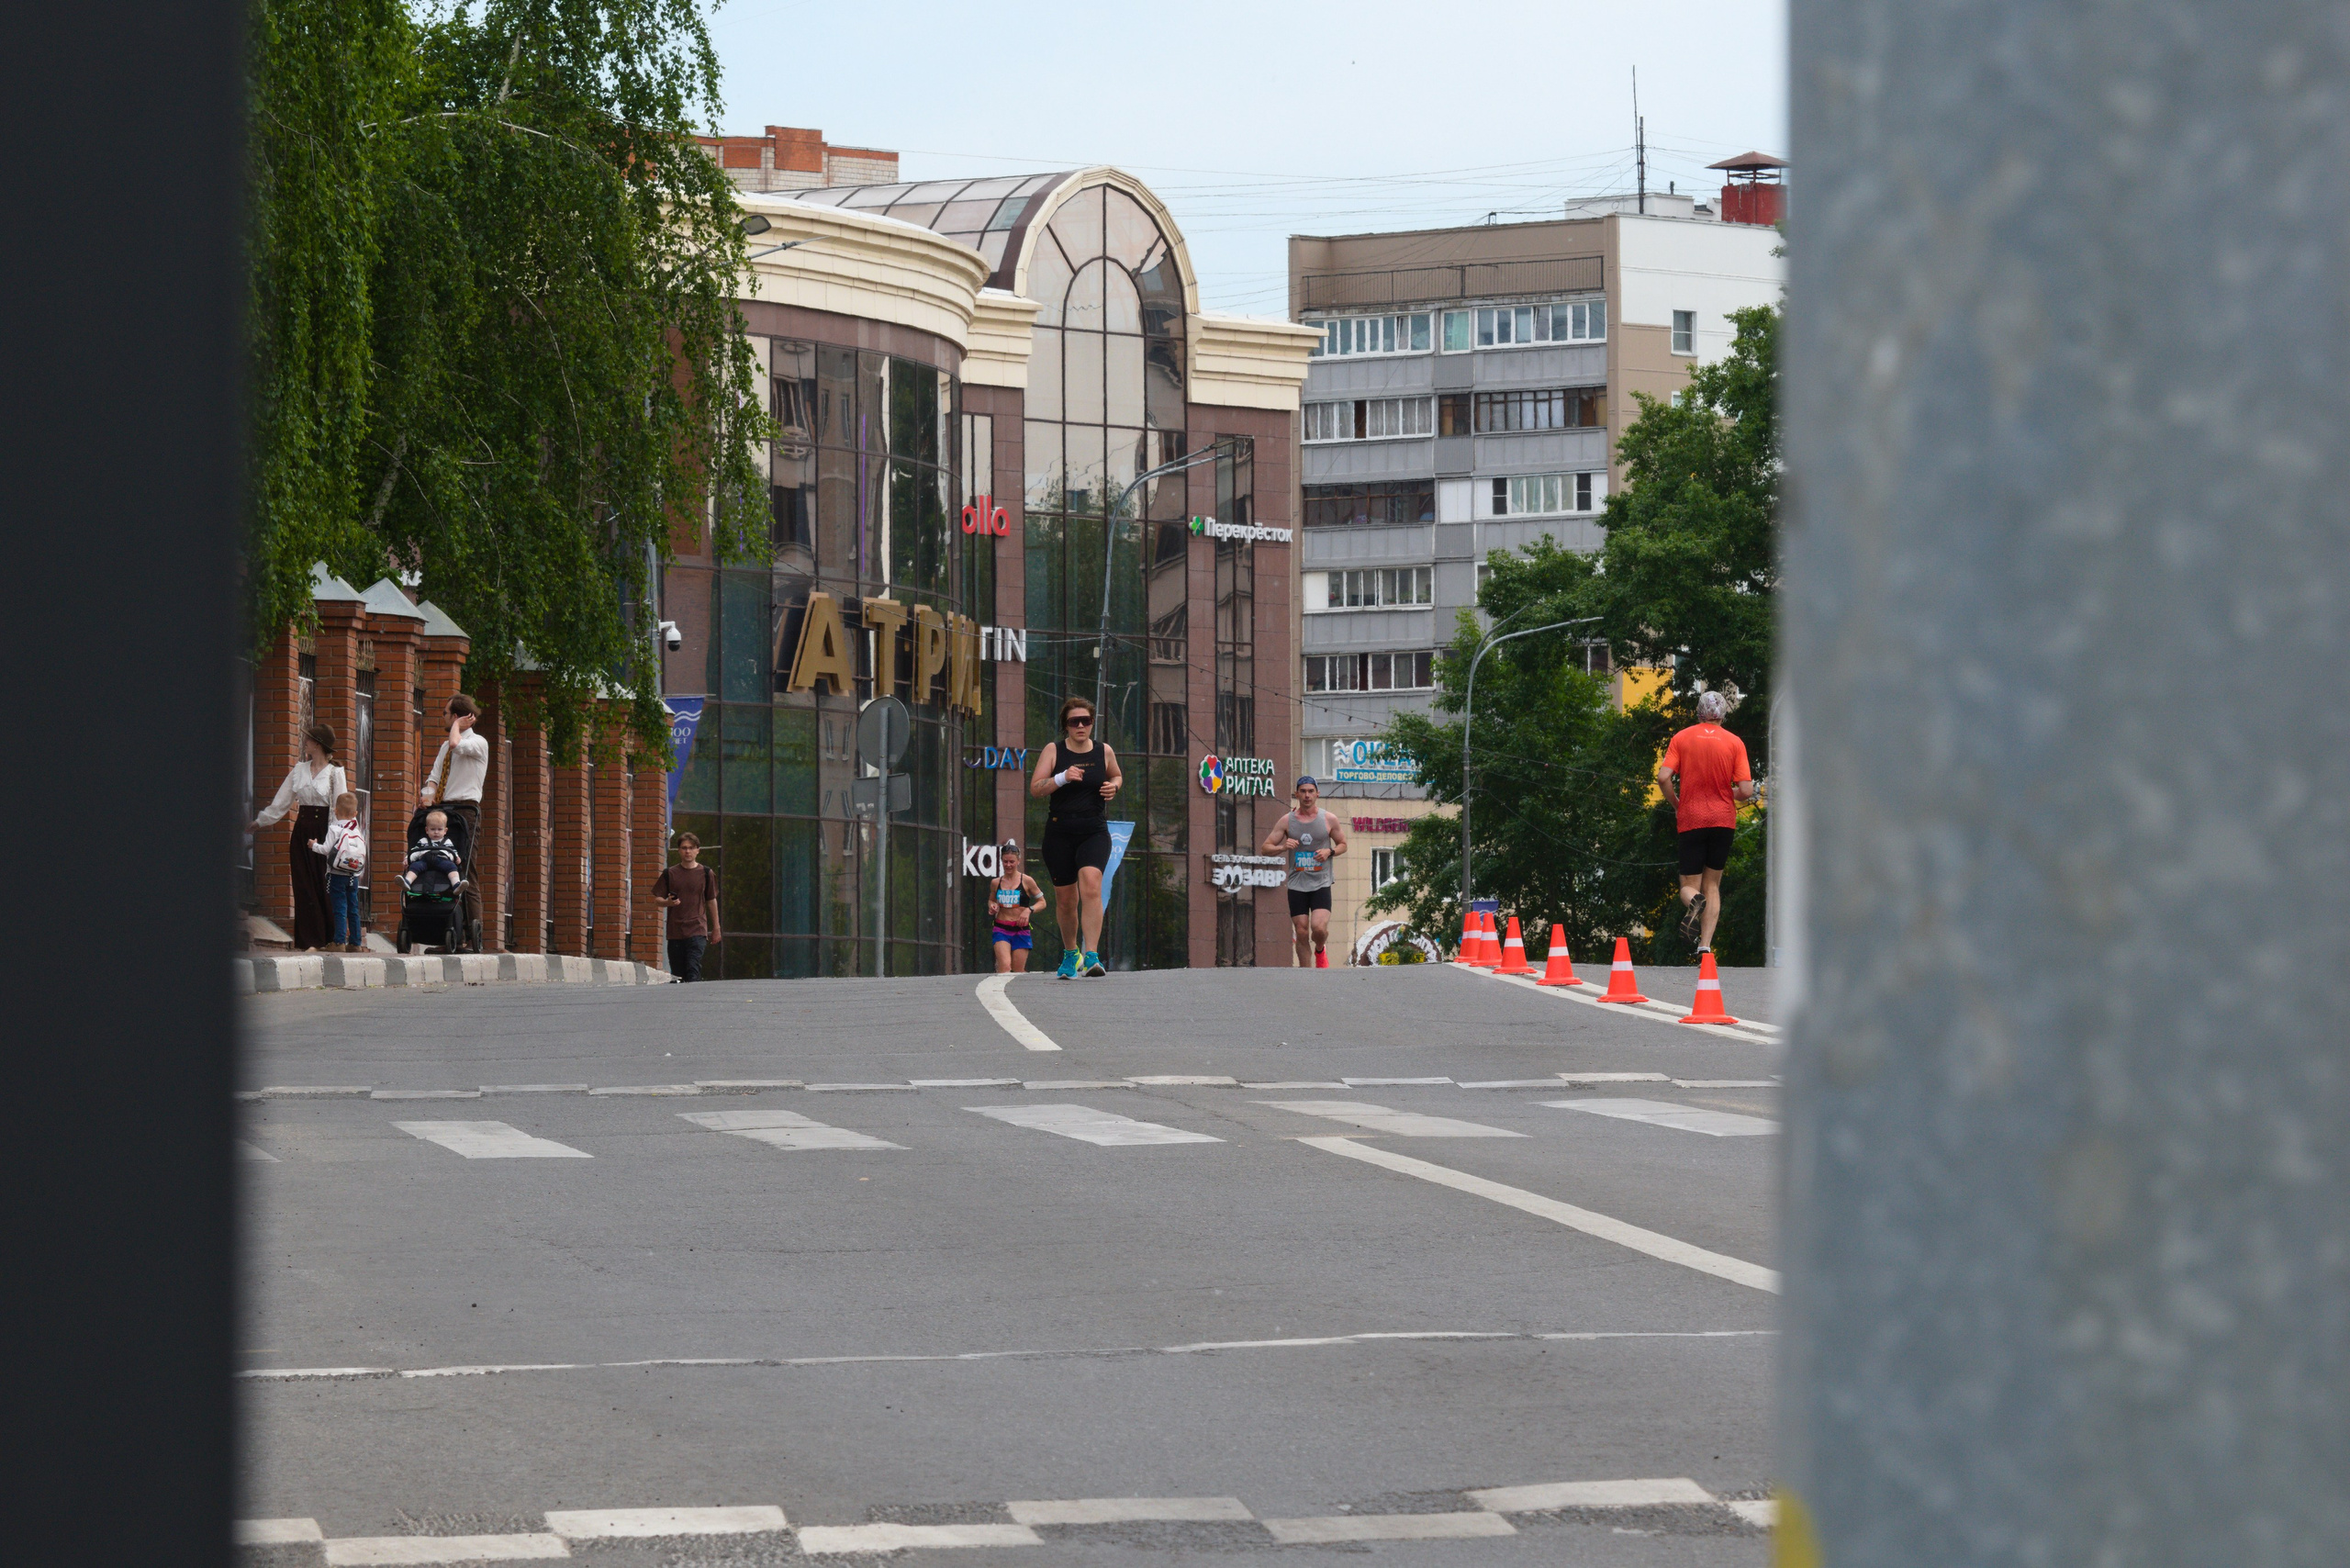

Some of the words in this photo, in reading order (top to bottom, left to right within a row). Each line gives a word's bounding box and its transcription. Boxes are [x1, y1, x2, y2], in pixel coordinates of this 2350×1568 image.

[1203, 517, 1293, 543] Перекрёсток
[984, 746, 1027, 769] DAY
[1350, 740, 1414, 767] ОКЕА
[1225, 756, 1275, 776] АПТЕКА
[1225, 775, 1275, 797] РИГЛА
[1351, 817, 1411, 834] WILDBER
